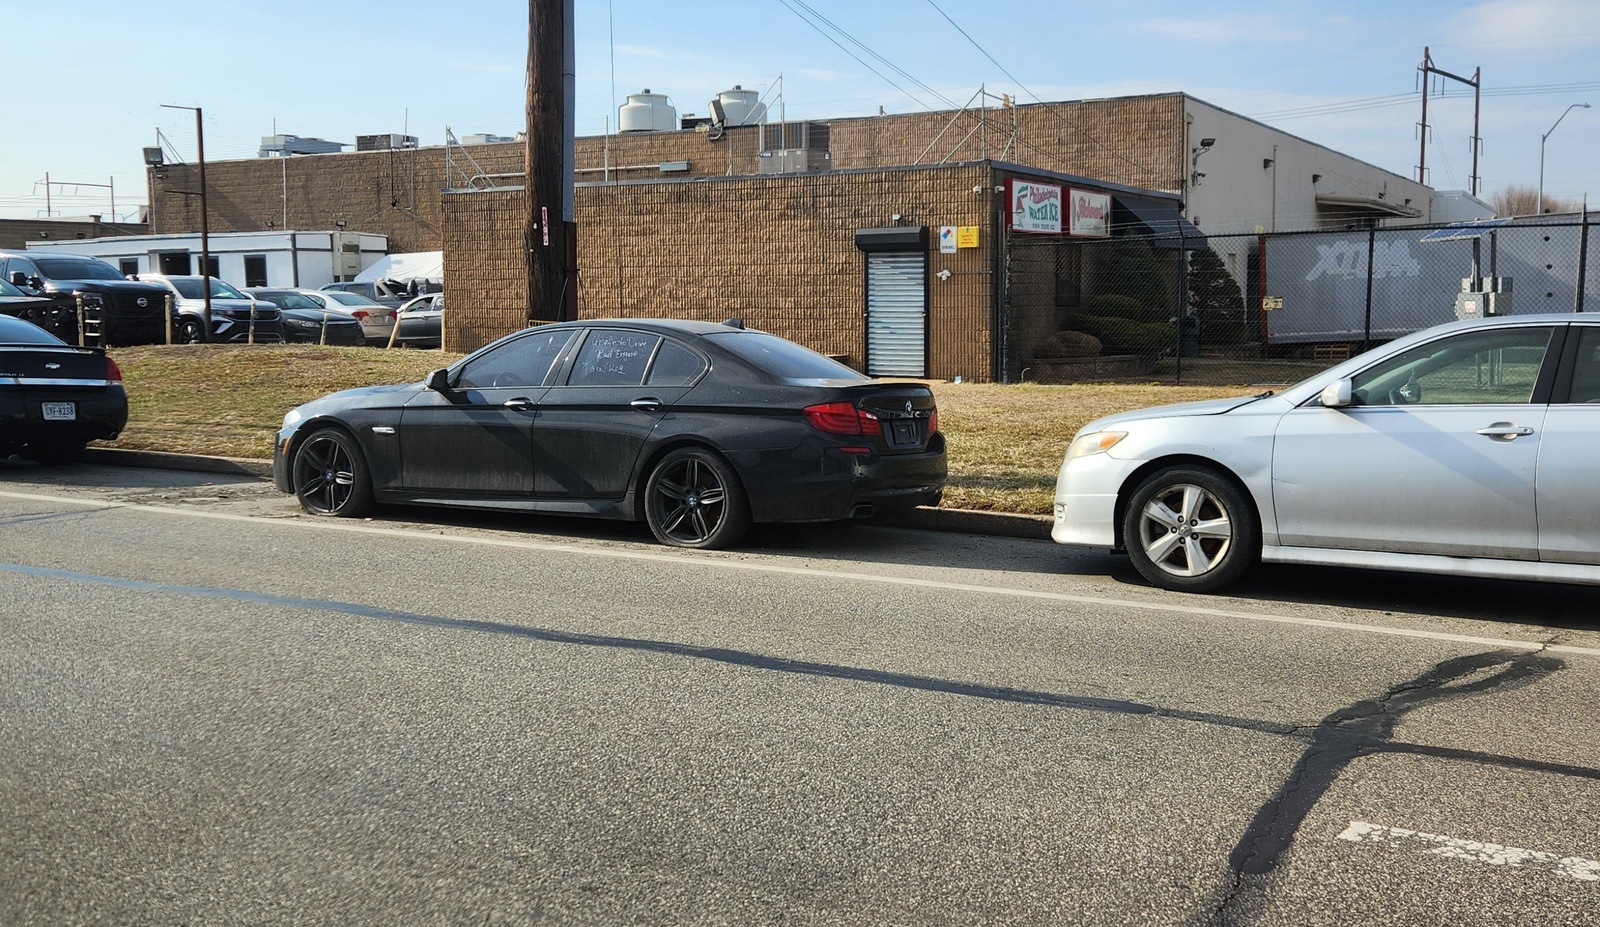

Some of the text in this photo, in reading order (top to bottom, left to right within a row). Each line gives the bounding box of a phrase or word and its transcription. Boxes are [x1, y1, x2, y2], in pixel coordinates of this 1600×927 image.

[1030, 186, 1058, 204] Philadelphia
[1029, 202, 1058, 221] WATER ICE
[618, 336, 626, 345] to
[595, 349, 613, 360] Bad
[582, 362, 606, 375] Tow
